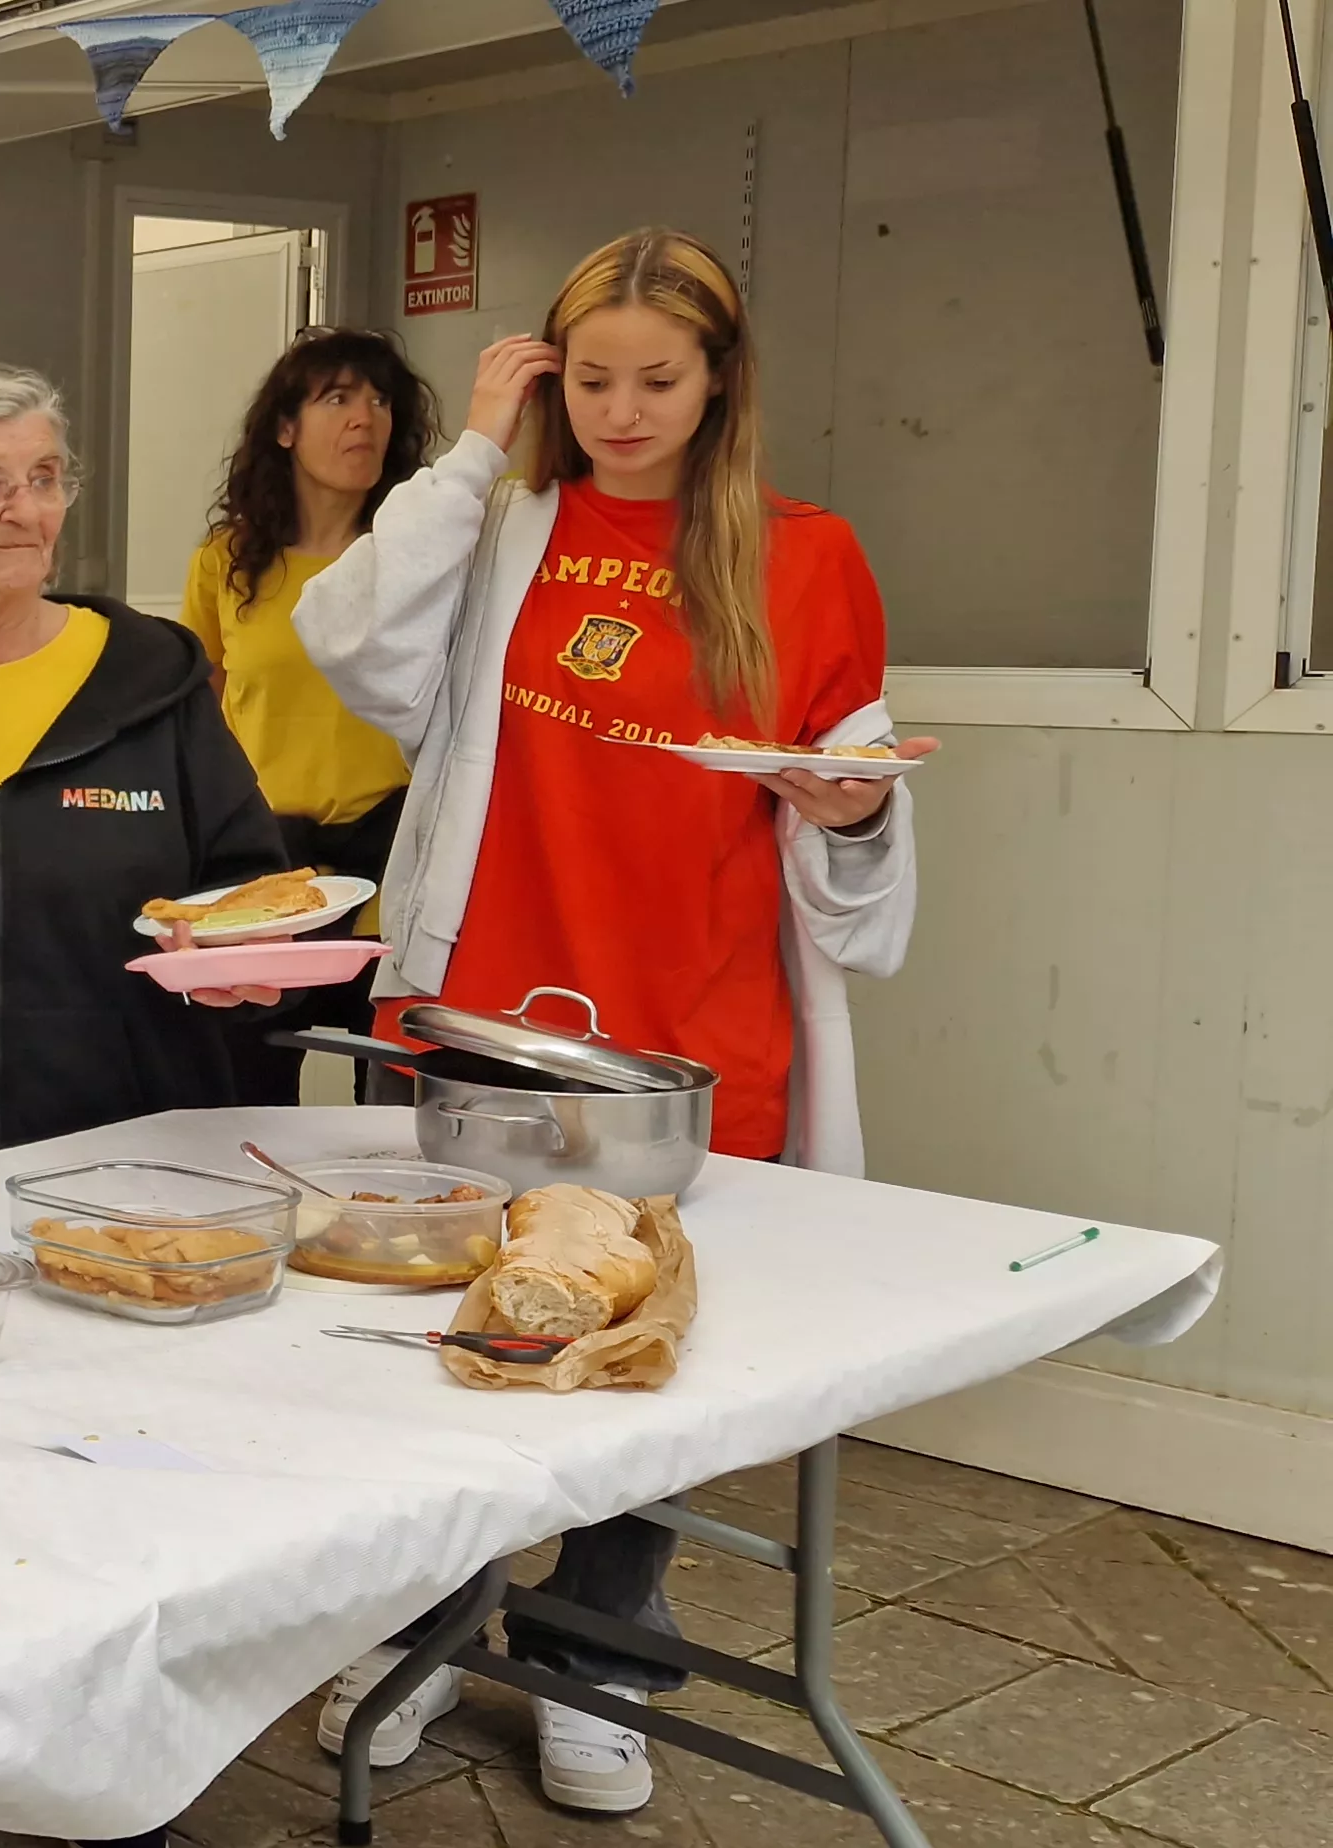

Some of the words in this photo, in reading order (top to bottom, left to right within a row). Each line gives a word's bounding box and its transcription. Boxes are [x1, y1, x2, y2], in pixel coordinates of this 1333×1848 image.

[408, 285, 470, 308] EXTINTOR
[533, 554, 683, 608] AMPEO
[608, 718, 673, 747] 2010
[62, 788, 165, 812] MEDANA
